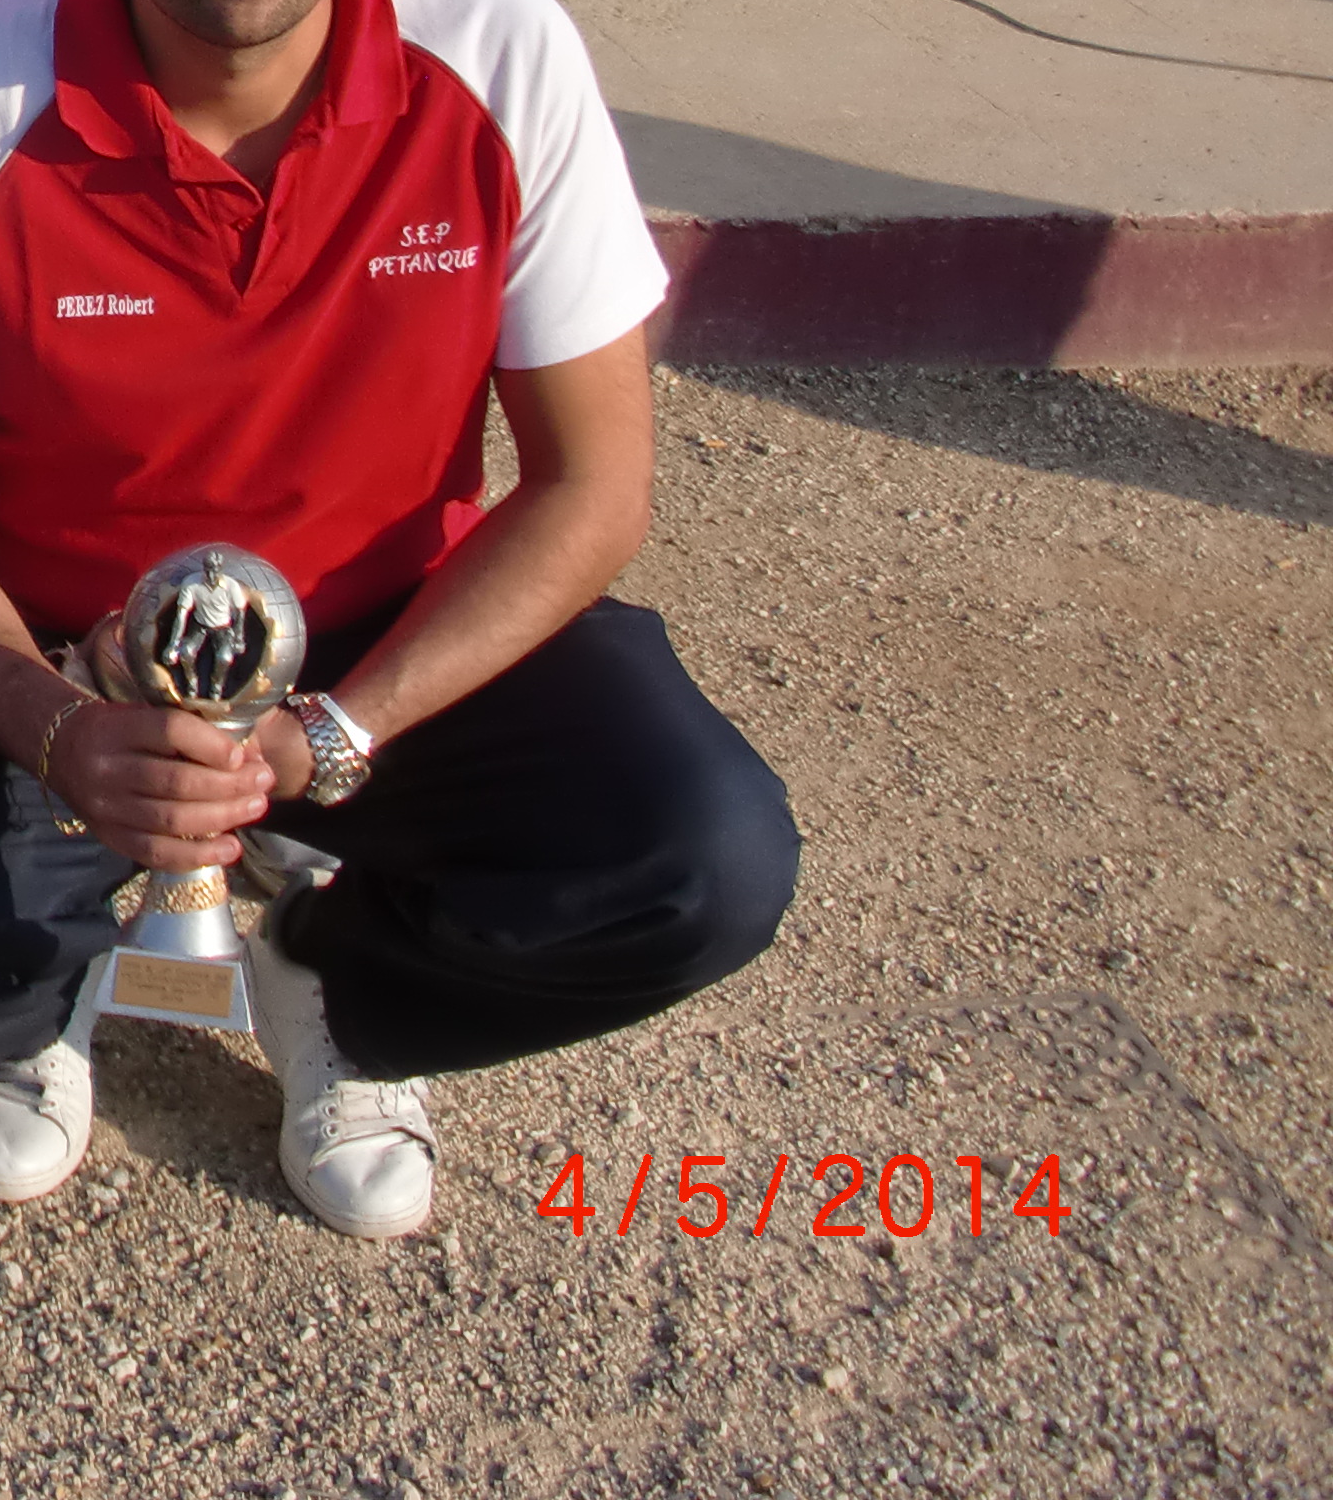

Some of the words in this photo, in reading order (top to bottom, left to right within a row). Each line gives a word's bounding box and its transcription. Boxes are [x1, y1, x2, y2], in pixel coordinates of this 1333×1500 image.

[368, 245, 479, 279] PETANQUE
[56, 294, 105, 318] PEREZ
[107, 293, 155, 316] Robert
